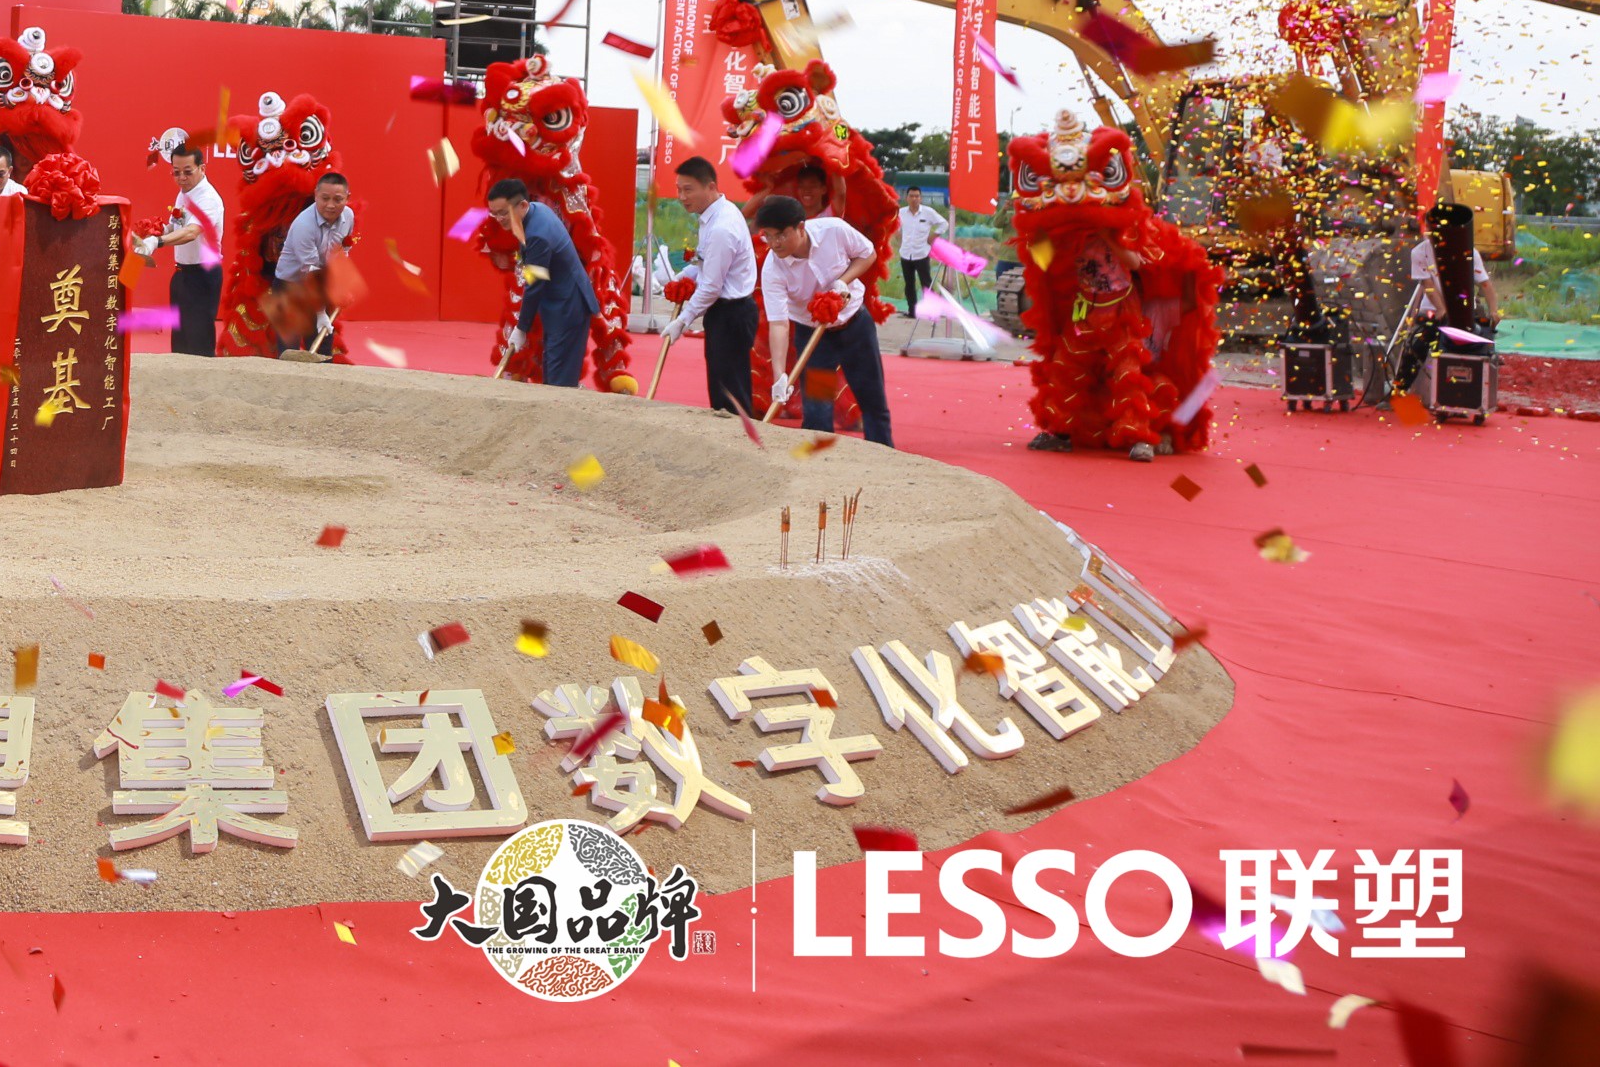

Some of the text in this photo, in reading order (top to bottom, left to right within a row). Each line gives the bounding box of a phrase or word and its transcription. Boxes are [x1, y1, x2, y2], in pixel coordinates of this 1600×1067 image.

[670, 19, 683, 72] FACTORY
[683, 40, 694, 55] OF
[668, 73, 679, 89] OF
[953, 87, 963, 127] CHINA
[950, 130, 959, 170] LESSO
[38, 263, 92, 415] 奠基
[101, 215, 121, 431] 联塑集团数字化智能工厂
